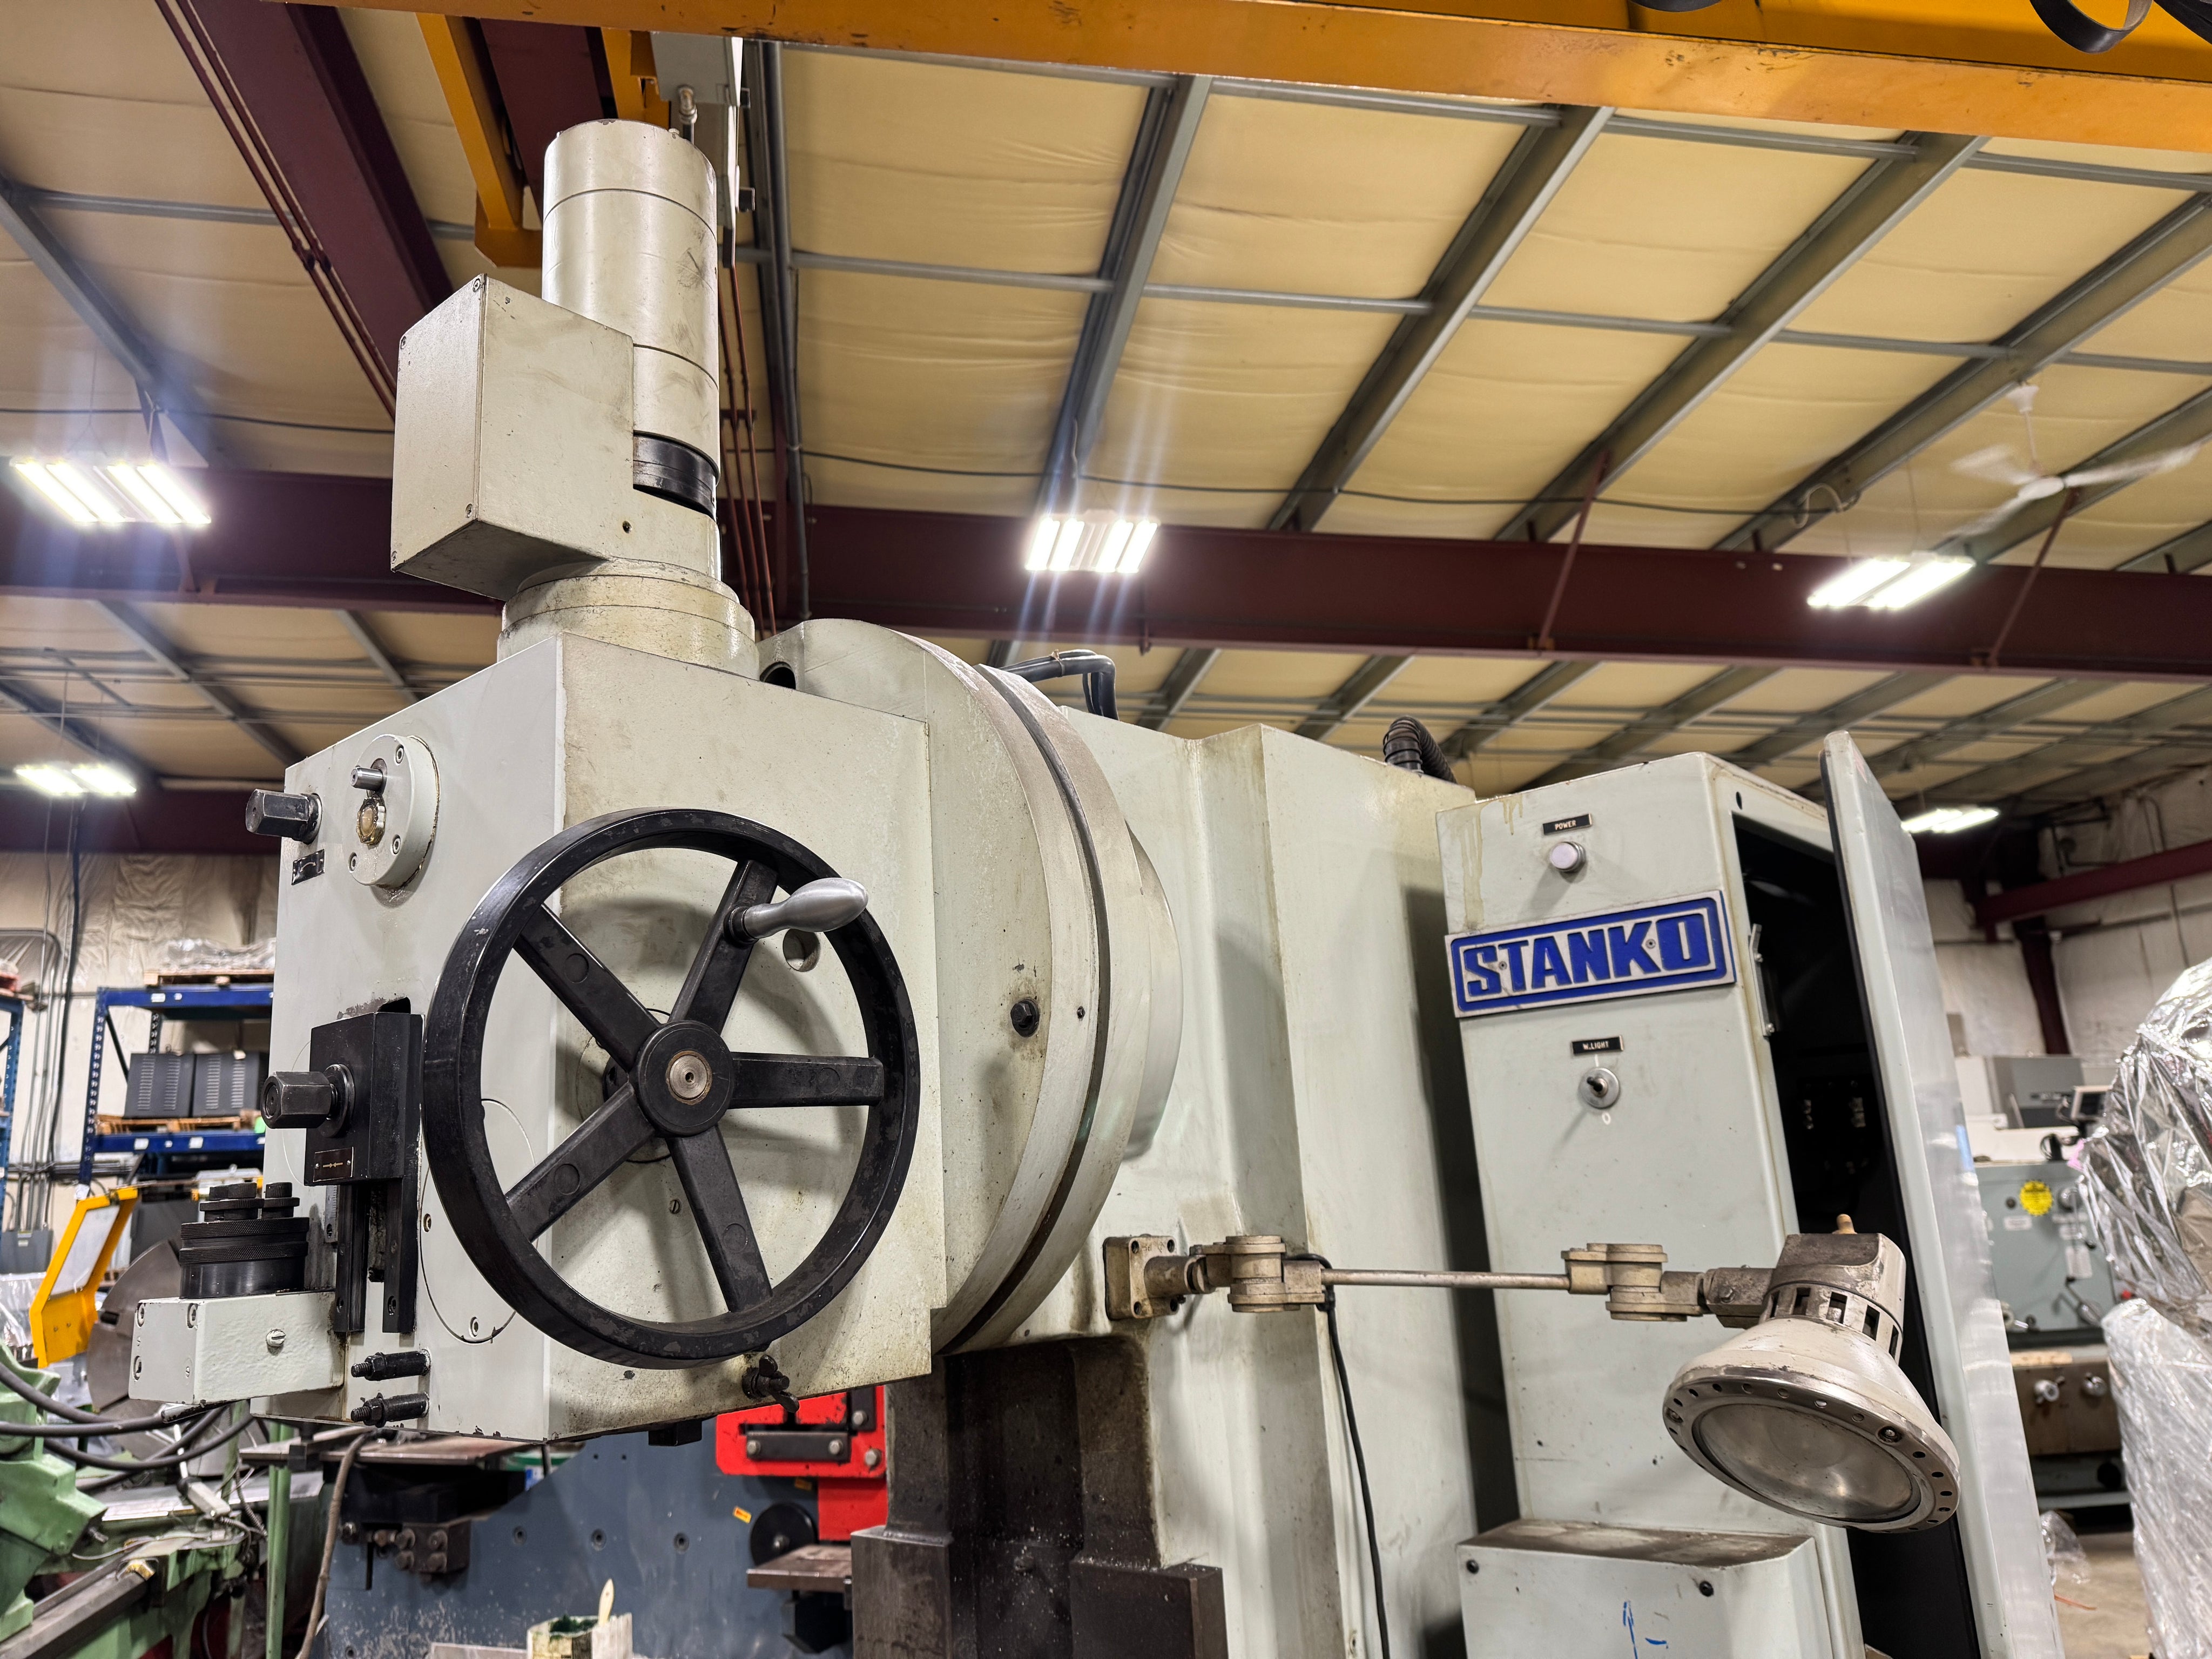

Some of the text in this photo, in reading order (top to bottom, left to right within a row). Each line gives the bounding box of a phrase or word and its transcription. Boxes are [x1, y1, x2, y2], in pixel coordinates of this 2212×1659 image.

[1555, 820, 1576, 830] POWER
[1463, 913, 1711, 997] STANKO
[1582, 1040, 1609, 1050] W.LIGHT
